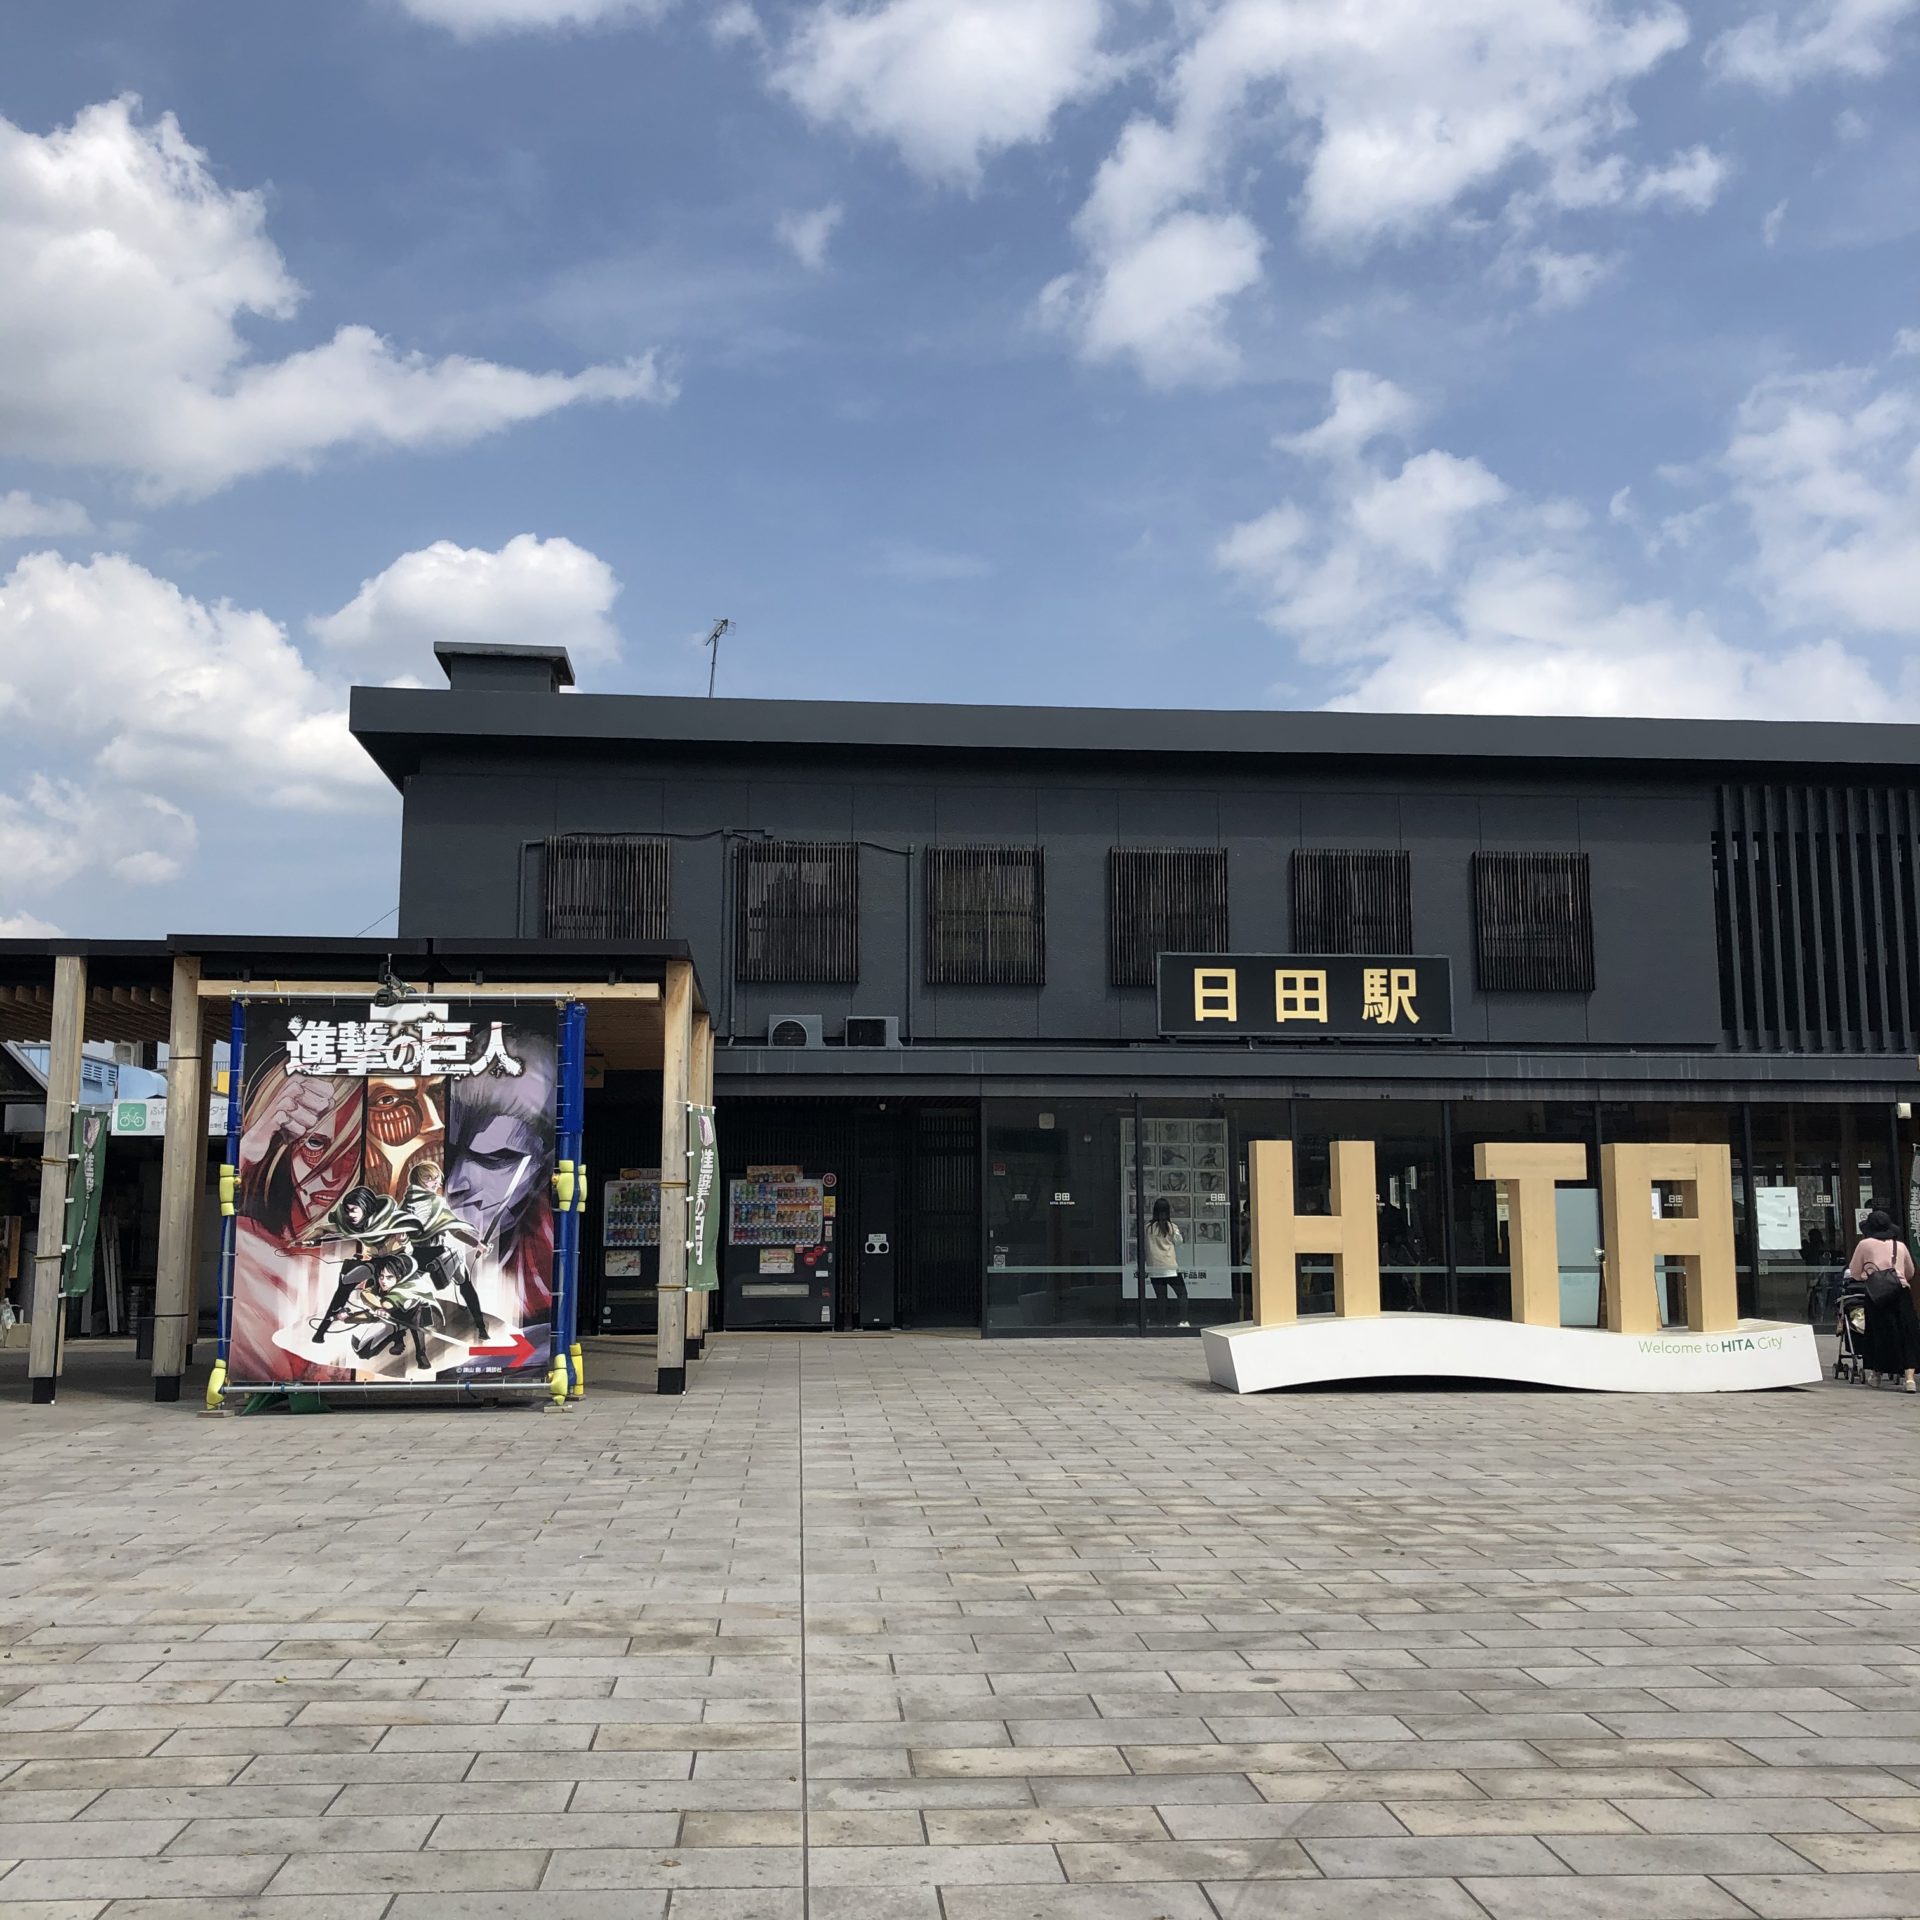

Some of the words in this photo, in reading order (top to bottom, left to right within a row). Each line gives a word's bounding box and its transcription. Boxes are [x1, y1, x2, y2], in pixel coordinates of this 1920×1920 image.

[1194, 967, 1420, 1025] 日田駅
[284, 1015, 523, 1080] 進撃の巨人
[1638, 1340, 1702, 1354] Welcome
[1705, 1342, 1719, 1353] to
[1721, 1339, 1755, 1352] HITA
[1757, 1336, 1783, 1350] City
